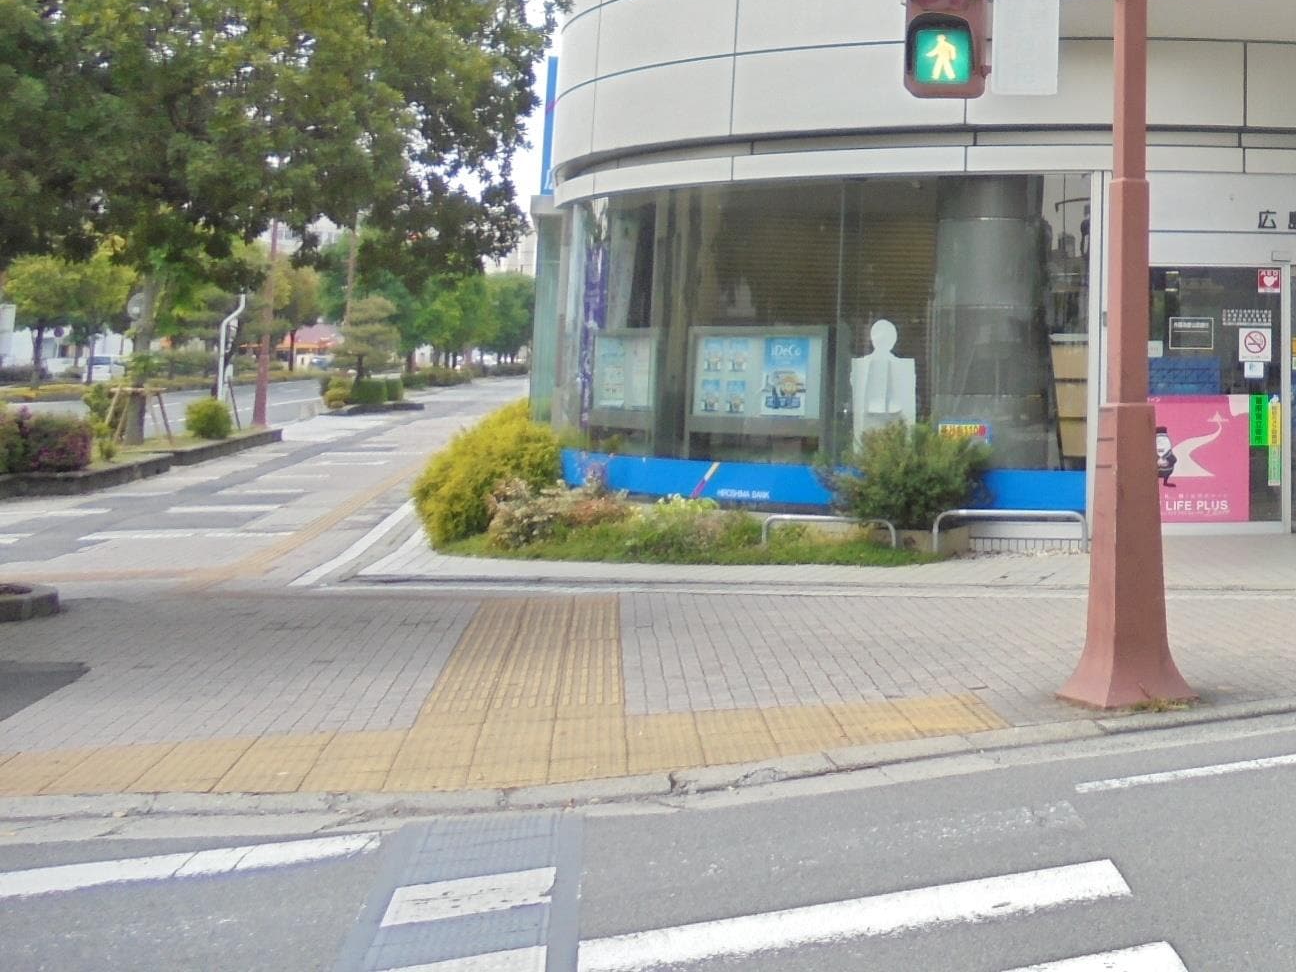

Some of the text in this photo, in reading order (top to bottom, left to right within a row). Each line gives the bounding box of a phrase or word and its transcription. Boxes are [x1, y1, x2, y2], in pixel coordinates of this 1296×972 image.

[1260, 269, 1279, 277] AED
[1165, 500, 1229, 511] LIFE PLUS
